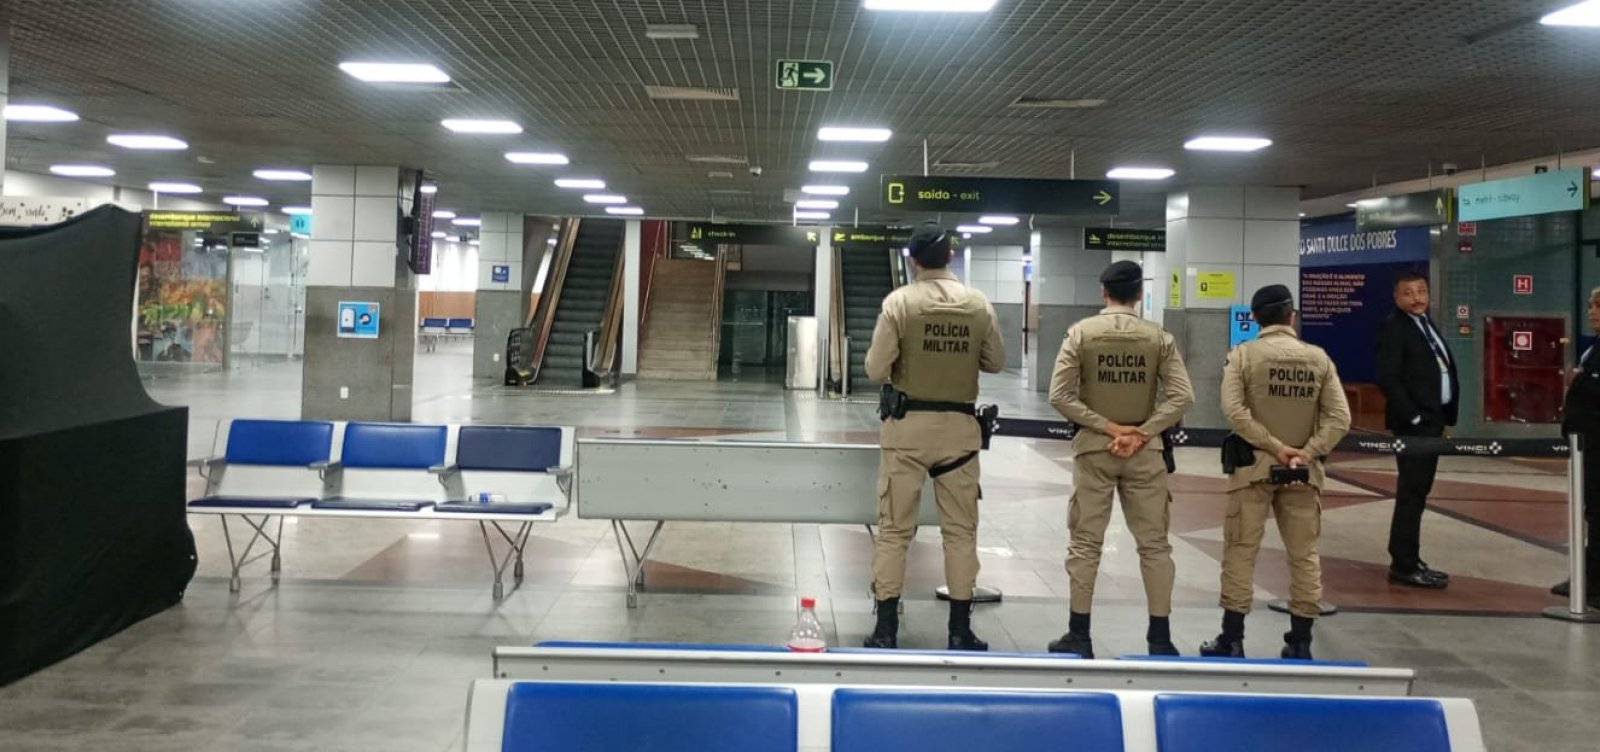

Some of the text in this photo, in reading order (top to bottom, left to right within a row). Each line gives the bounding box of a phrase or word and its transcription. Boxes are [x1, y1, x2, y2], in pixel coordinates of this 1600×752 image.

[960, 190, 980, 200] exit
[1306, 237, 1326, 255] SANTA
[1327, 235, 1349, 253] DULCE
[1350, 233, 1366, 251] DOS
[1367, 230, 1397, 250] POBRES
[1517, 278, 1529, 289] H
[924, 321, 970, 337] POLÍCIA
[923, 339, 970, 352] MILITAR
[1098, 352, 1146, 368] POLÍCIA
[1098, 371, 1146, 384] MILITAR
[1269, 366, 1315, 383] POLÍCIA
[1268, 384, 1315, 398] MILITAR
[1359, 441, 1391, 449] VINCI
